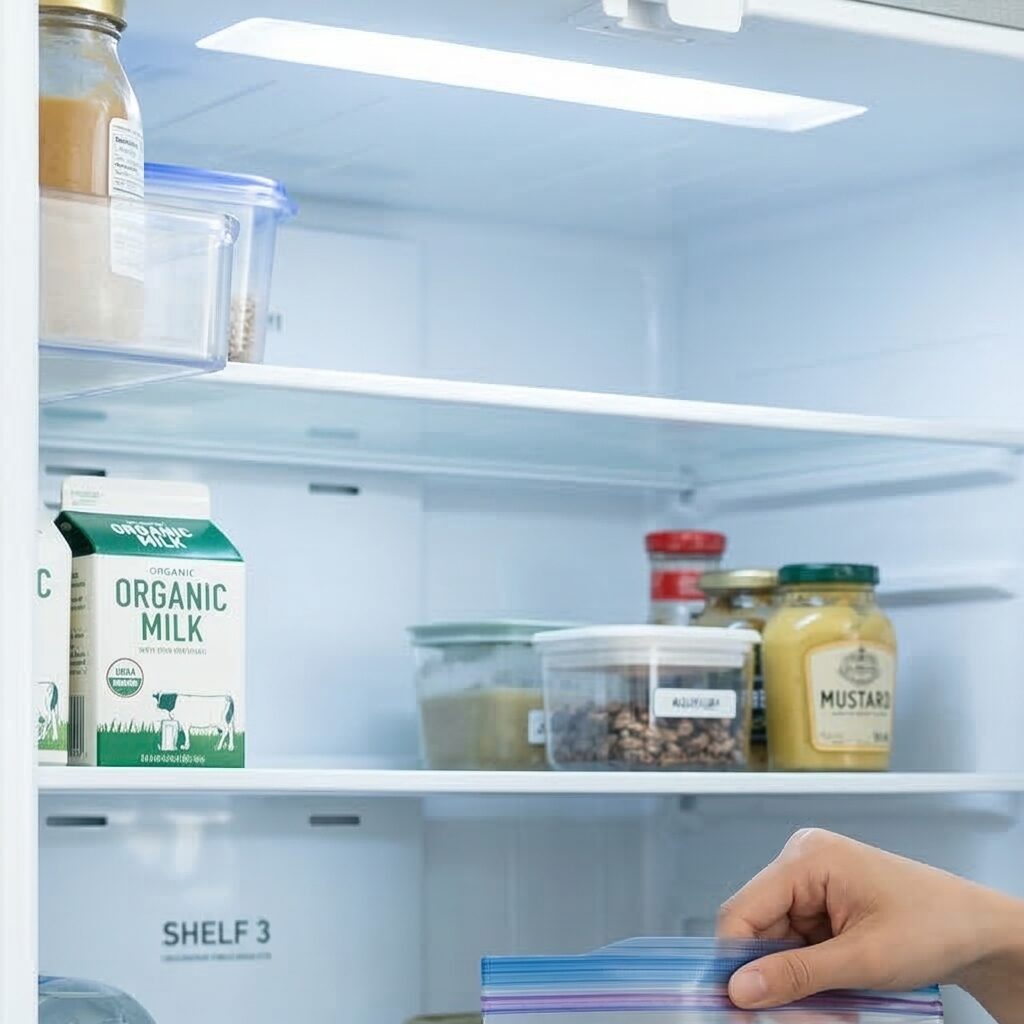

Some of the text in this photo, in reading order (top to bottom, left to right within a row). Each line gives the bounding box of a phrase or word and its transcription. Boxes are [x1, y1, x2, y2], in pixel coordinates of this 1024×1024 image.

[115, 578, 228, 612] ORGANIC
[141, 612, 204, 642] MILK
[163, 919, 271, 946] SHELF 3
